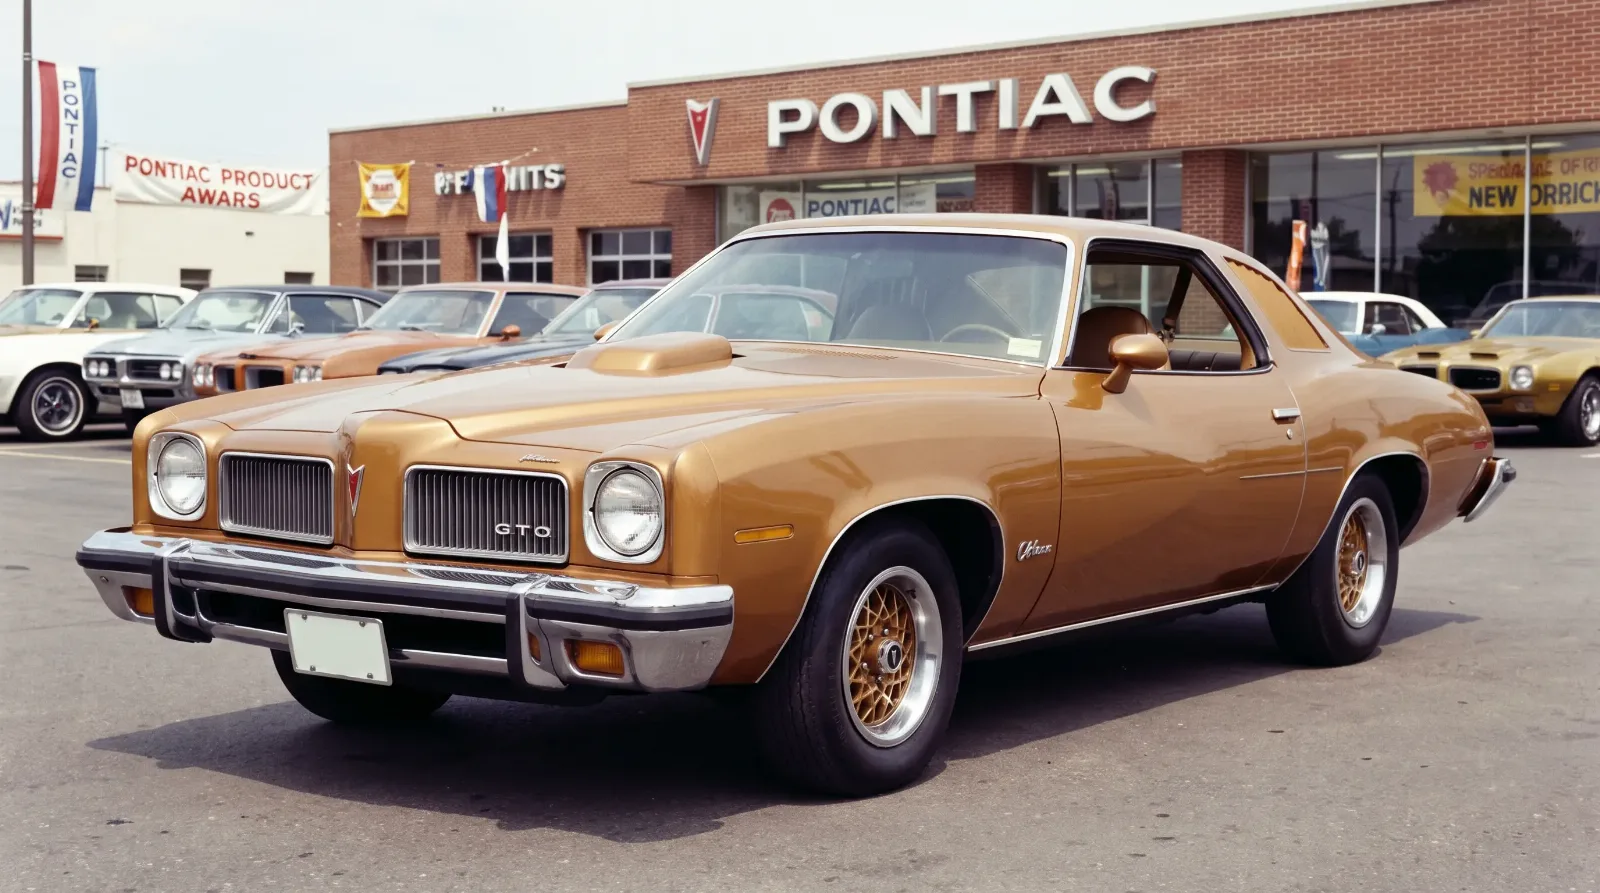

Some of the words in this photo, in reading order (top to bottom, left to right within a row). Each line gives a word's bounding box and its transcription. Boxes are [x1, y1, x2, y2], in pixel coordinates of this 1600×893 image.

[767, 66, 1157, 148] PONTIAC
[62, 80, 79, 178] PONTIAC
[125, 155, 211, 183] PONTIAC
[221, 168, 313, 190] PRODUCT
[180, 187, 260, 209] AWARS
[807, 196, 895, 218] PONTIAC
[1468, 185, 1518, 208] NEW
[494, 523, 551, 538] GTO
